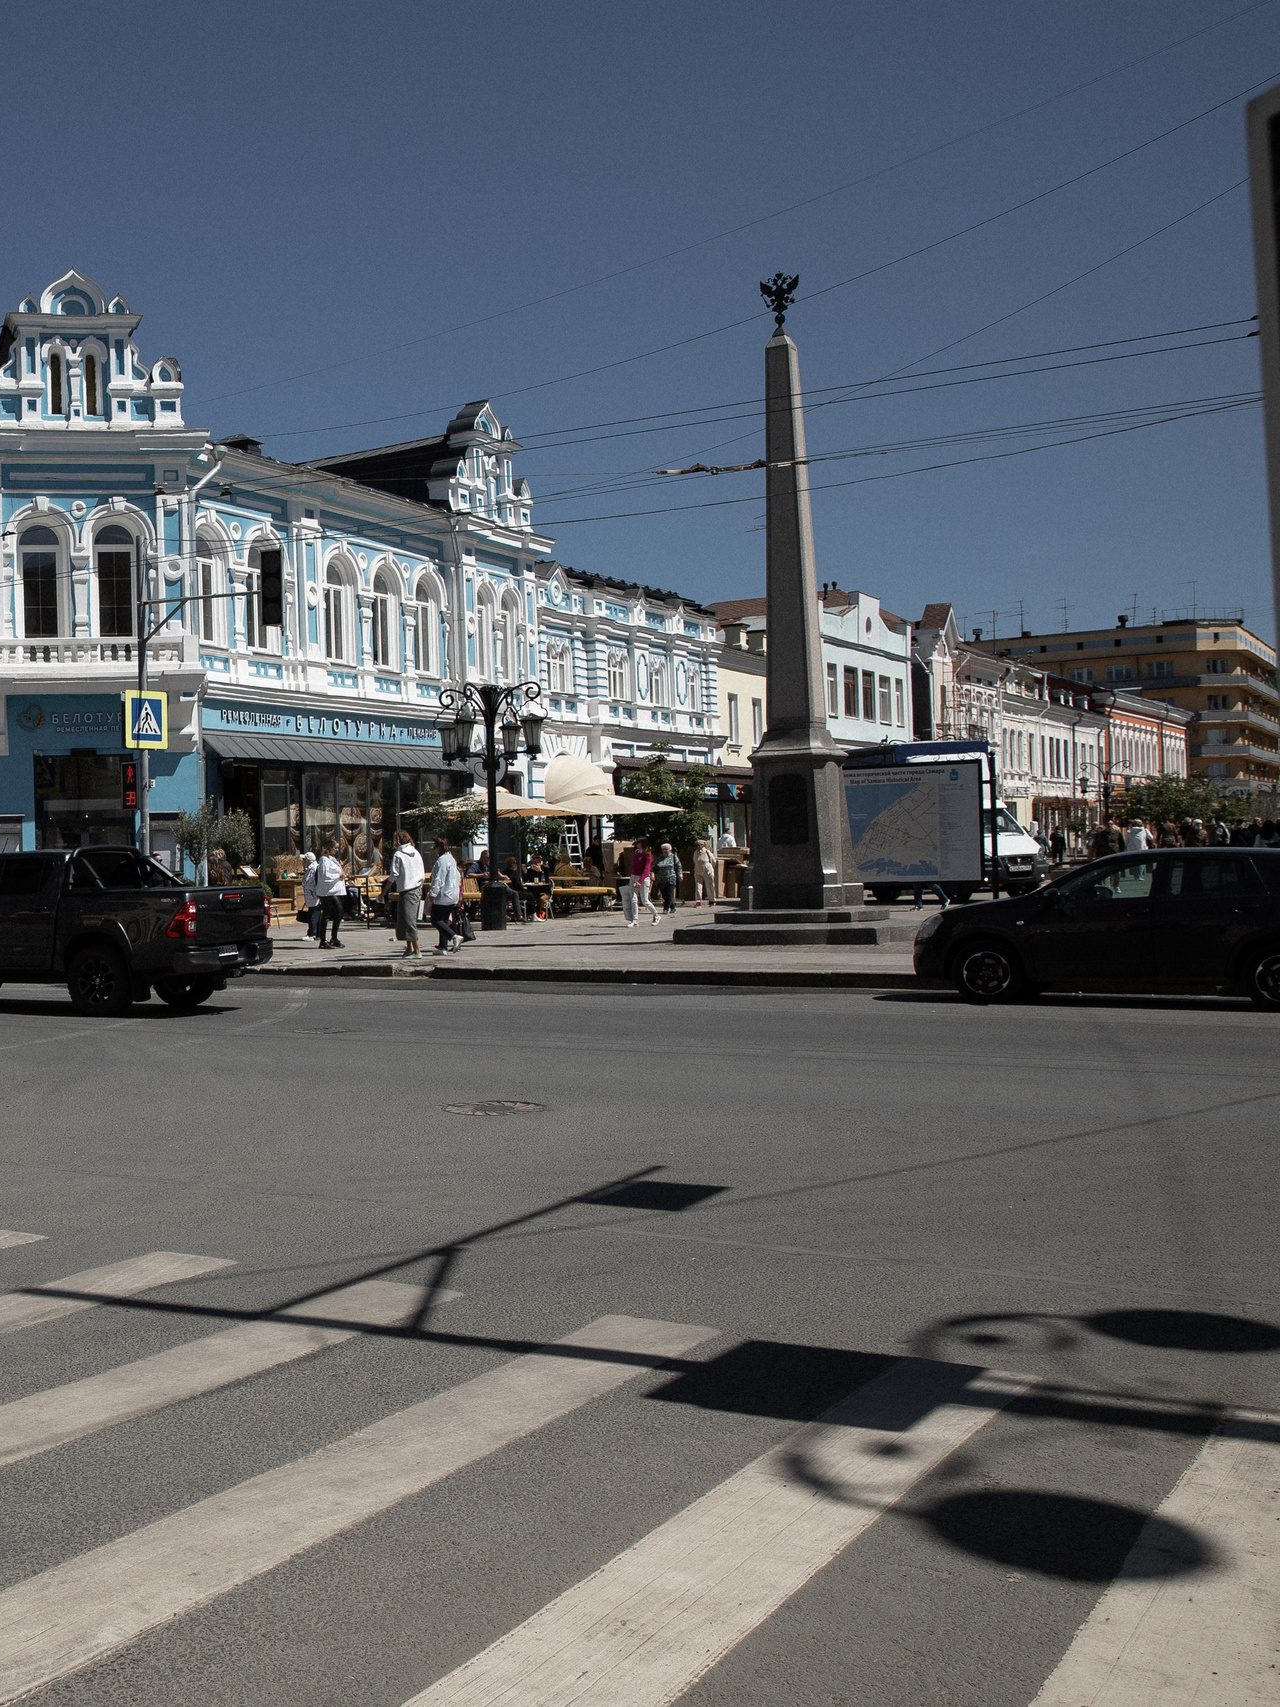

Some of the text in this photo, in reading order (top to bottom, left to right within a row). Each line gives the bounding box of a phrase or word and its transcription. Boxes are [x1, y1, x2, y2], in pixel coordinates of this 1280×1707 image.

[56, 725, 108, 733] РЕМЕСЛЕННАЯ
[221, 708, 282, 726] РЕМЕСЛЕННАЯ
[296, 714, 398, 738] БЕЛОТУРКА
[125, 791, 136, 806] 39
